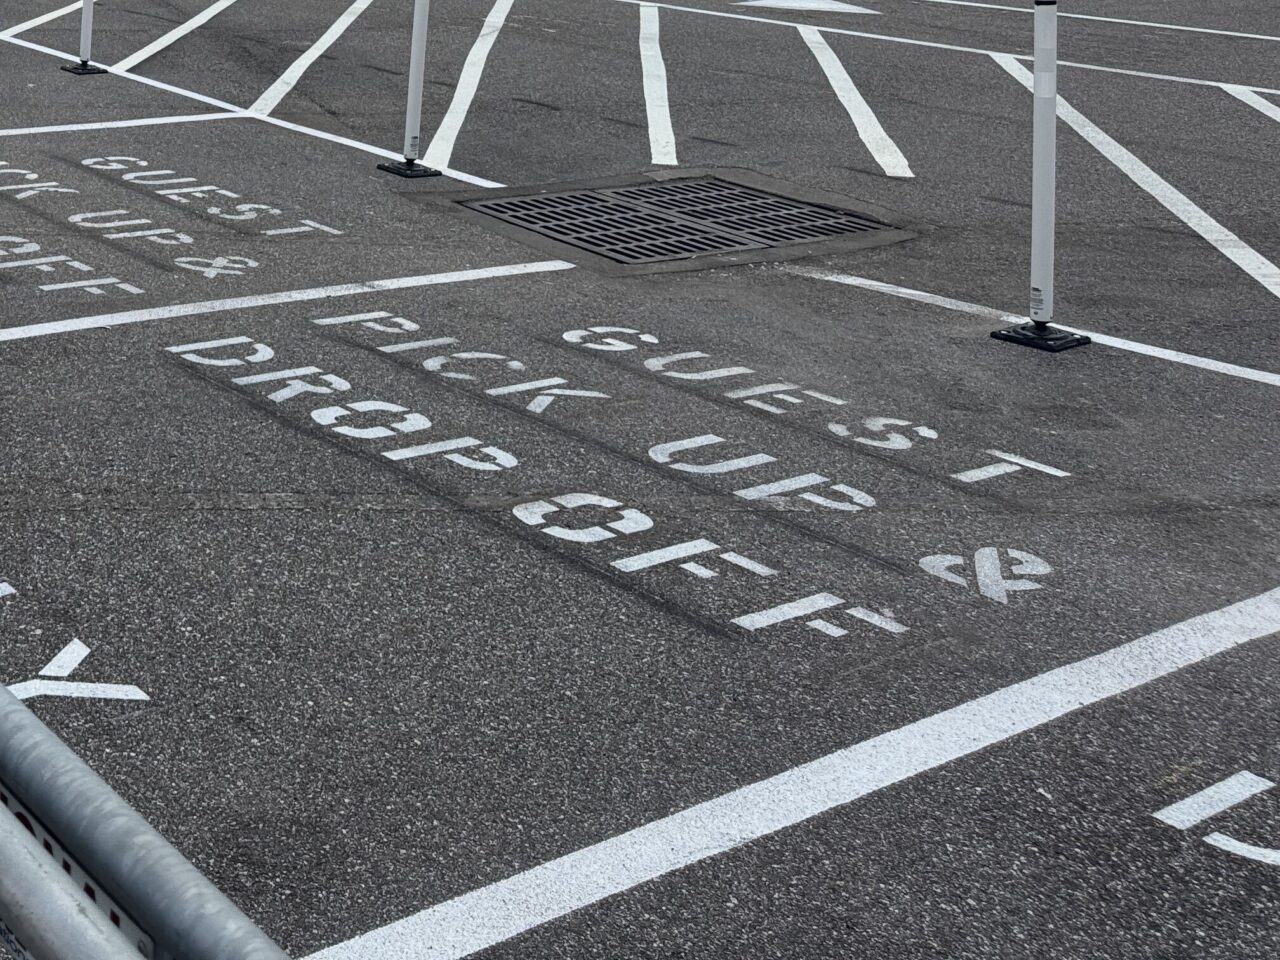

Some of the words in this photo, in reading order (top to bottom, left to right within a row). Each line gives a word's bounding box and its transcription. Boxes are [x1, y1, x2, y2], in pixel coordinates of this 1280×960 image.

[66, 208, 195, 246] UP
[173, 254, 260, 280] &
[80, 155, 346, 236] GUEST
[311, 309, 612, 414] PICK
[646, 433, 879, 514] UP
[918, 545, 1055, 604] &
[560, 324, 1074, 484] GUEST
[164, 334, 520, 472] DROP
[510, 491, 912, 640] OFF
